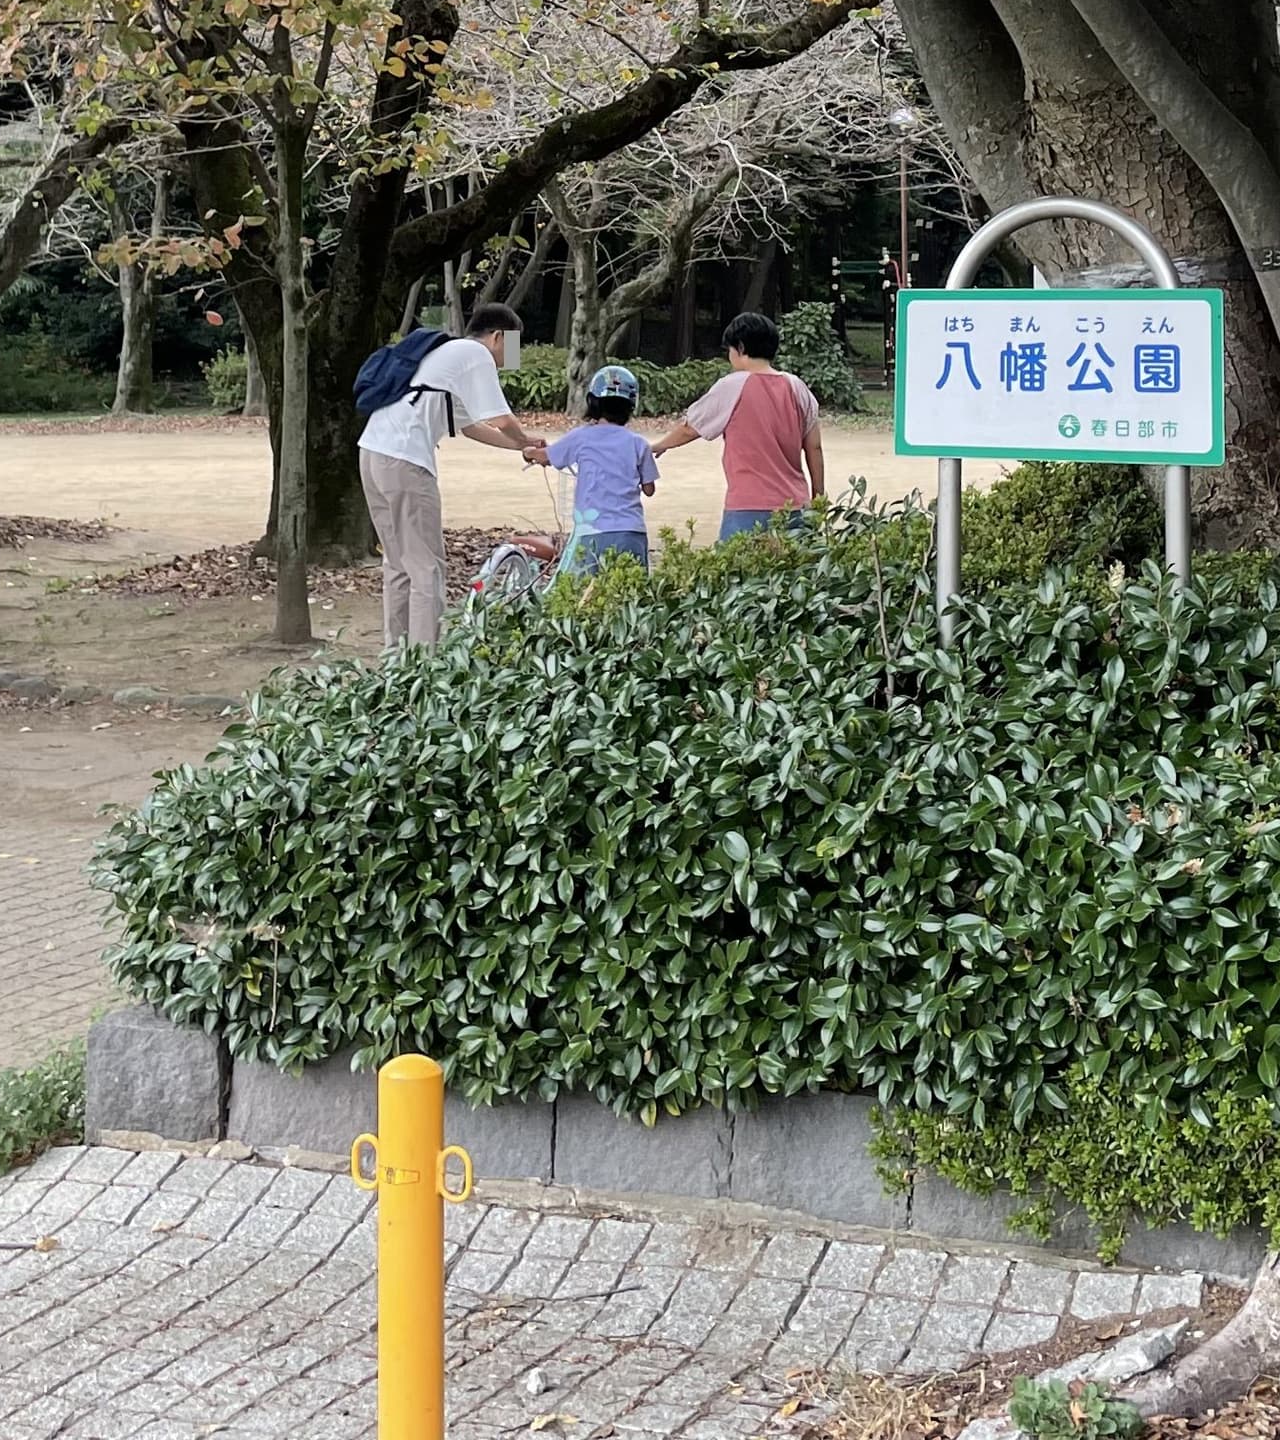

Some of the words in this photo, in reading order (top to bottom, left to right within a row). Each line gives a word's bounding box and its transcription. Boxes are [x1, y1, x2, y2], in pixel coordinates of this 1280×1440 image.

[944, 317, 975, 333] はち
[1009, 316, 1041, 333] まん
[1075, 316, 1106, 333] こう
[1141, 316, 1175, 334] えん
[935, 341, 1181, 394] 八幡公園
[1091, 418, 1179, 439] 春日部市
